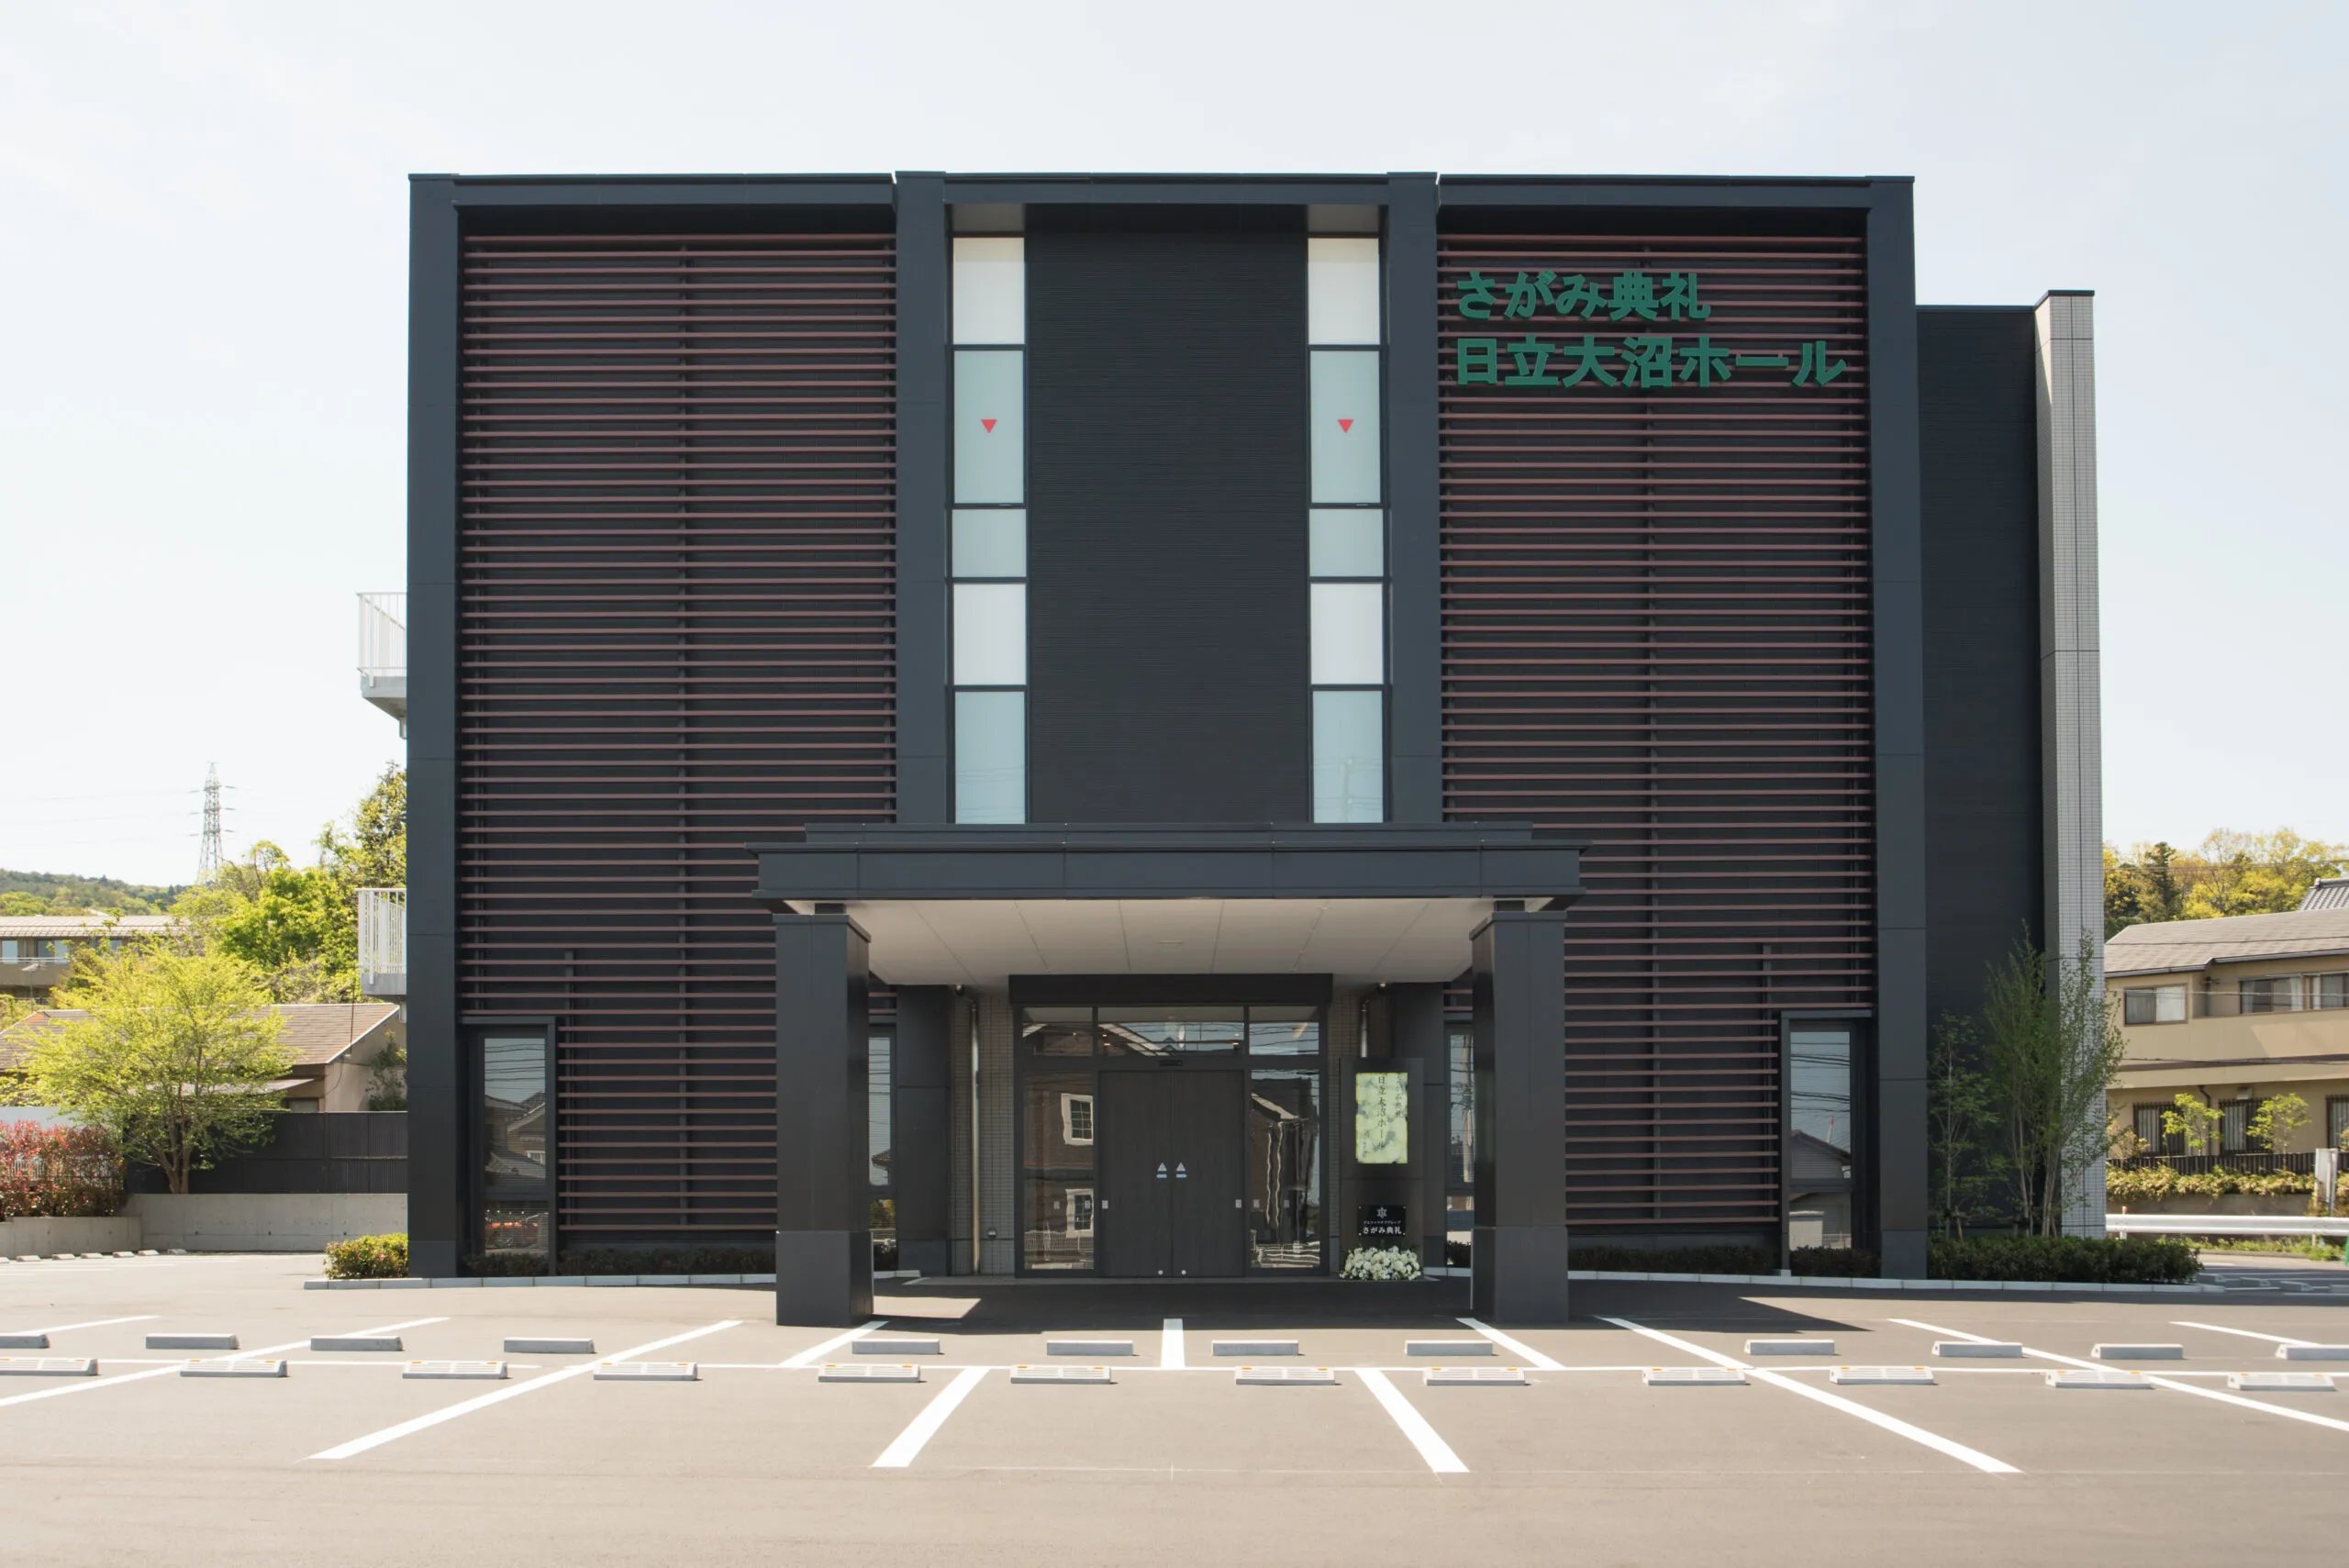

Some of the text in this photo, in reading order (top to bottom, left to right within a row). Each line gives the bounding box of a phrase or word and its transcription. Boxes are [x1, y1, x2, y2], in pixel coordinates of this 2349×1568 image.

[1457, 270, 1711, 321] さがみ典礼
[1455, 335, 1848, 388] 日立大沼ホール
[1377, 1075, 1386, 1149] 日立大沼ホール
[1363, 1226, 1402, 1235] さがみ典礼
